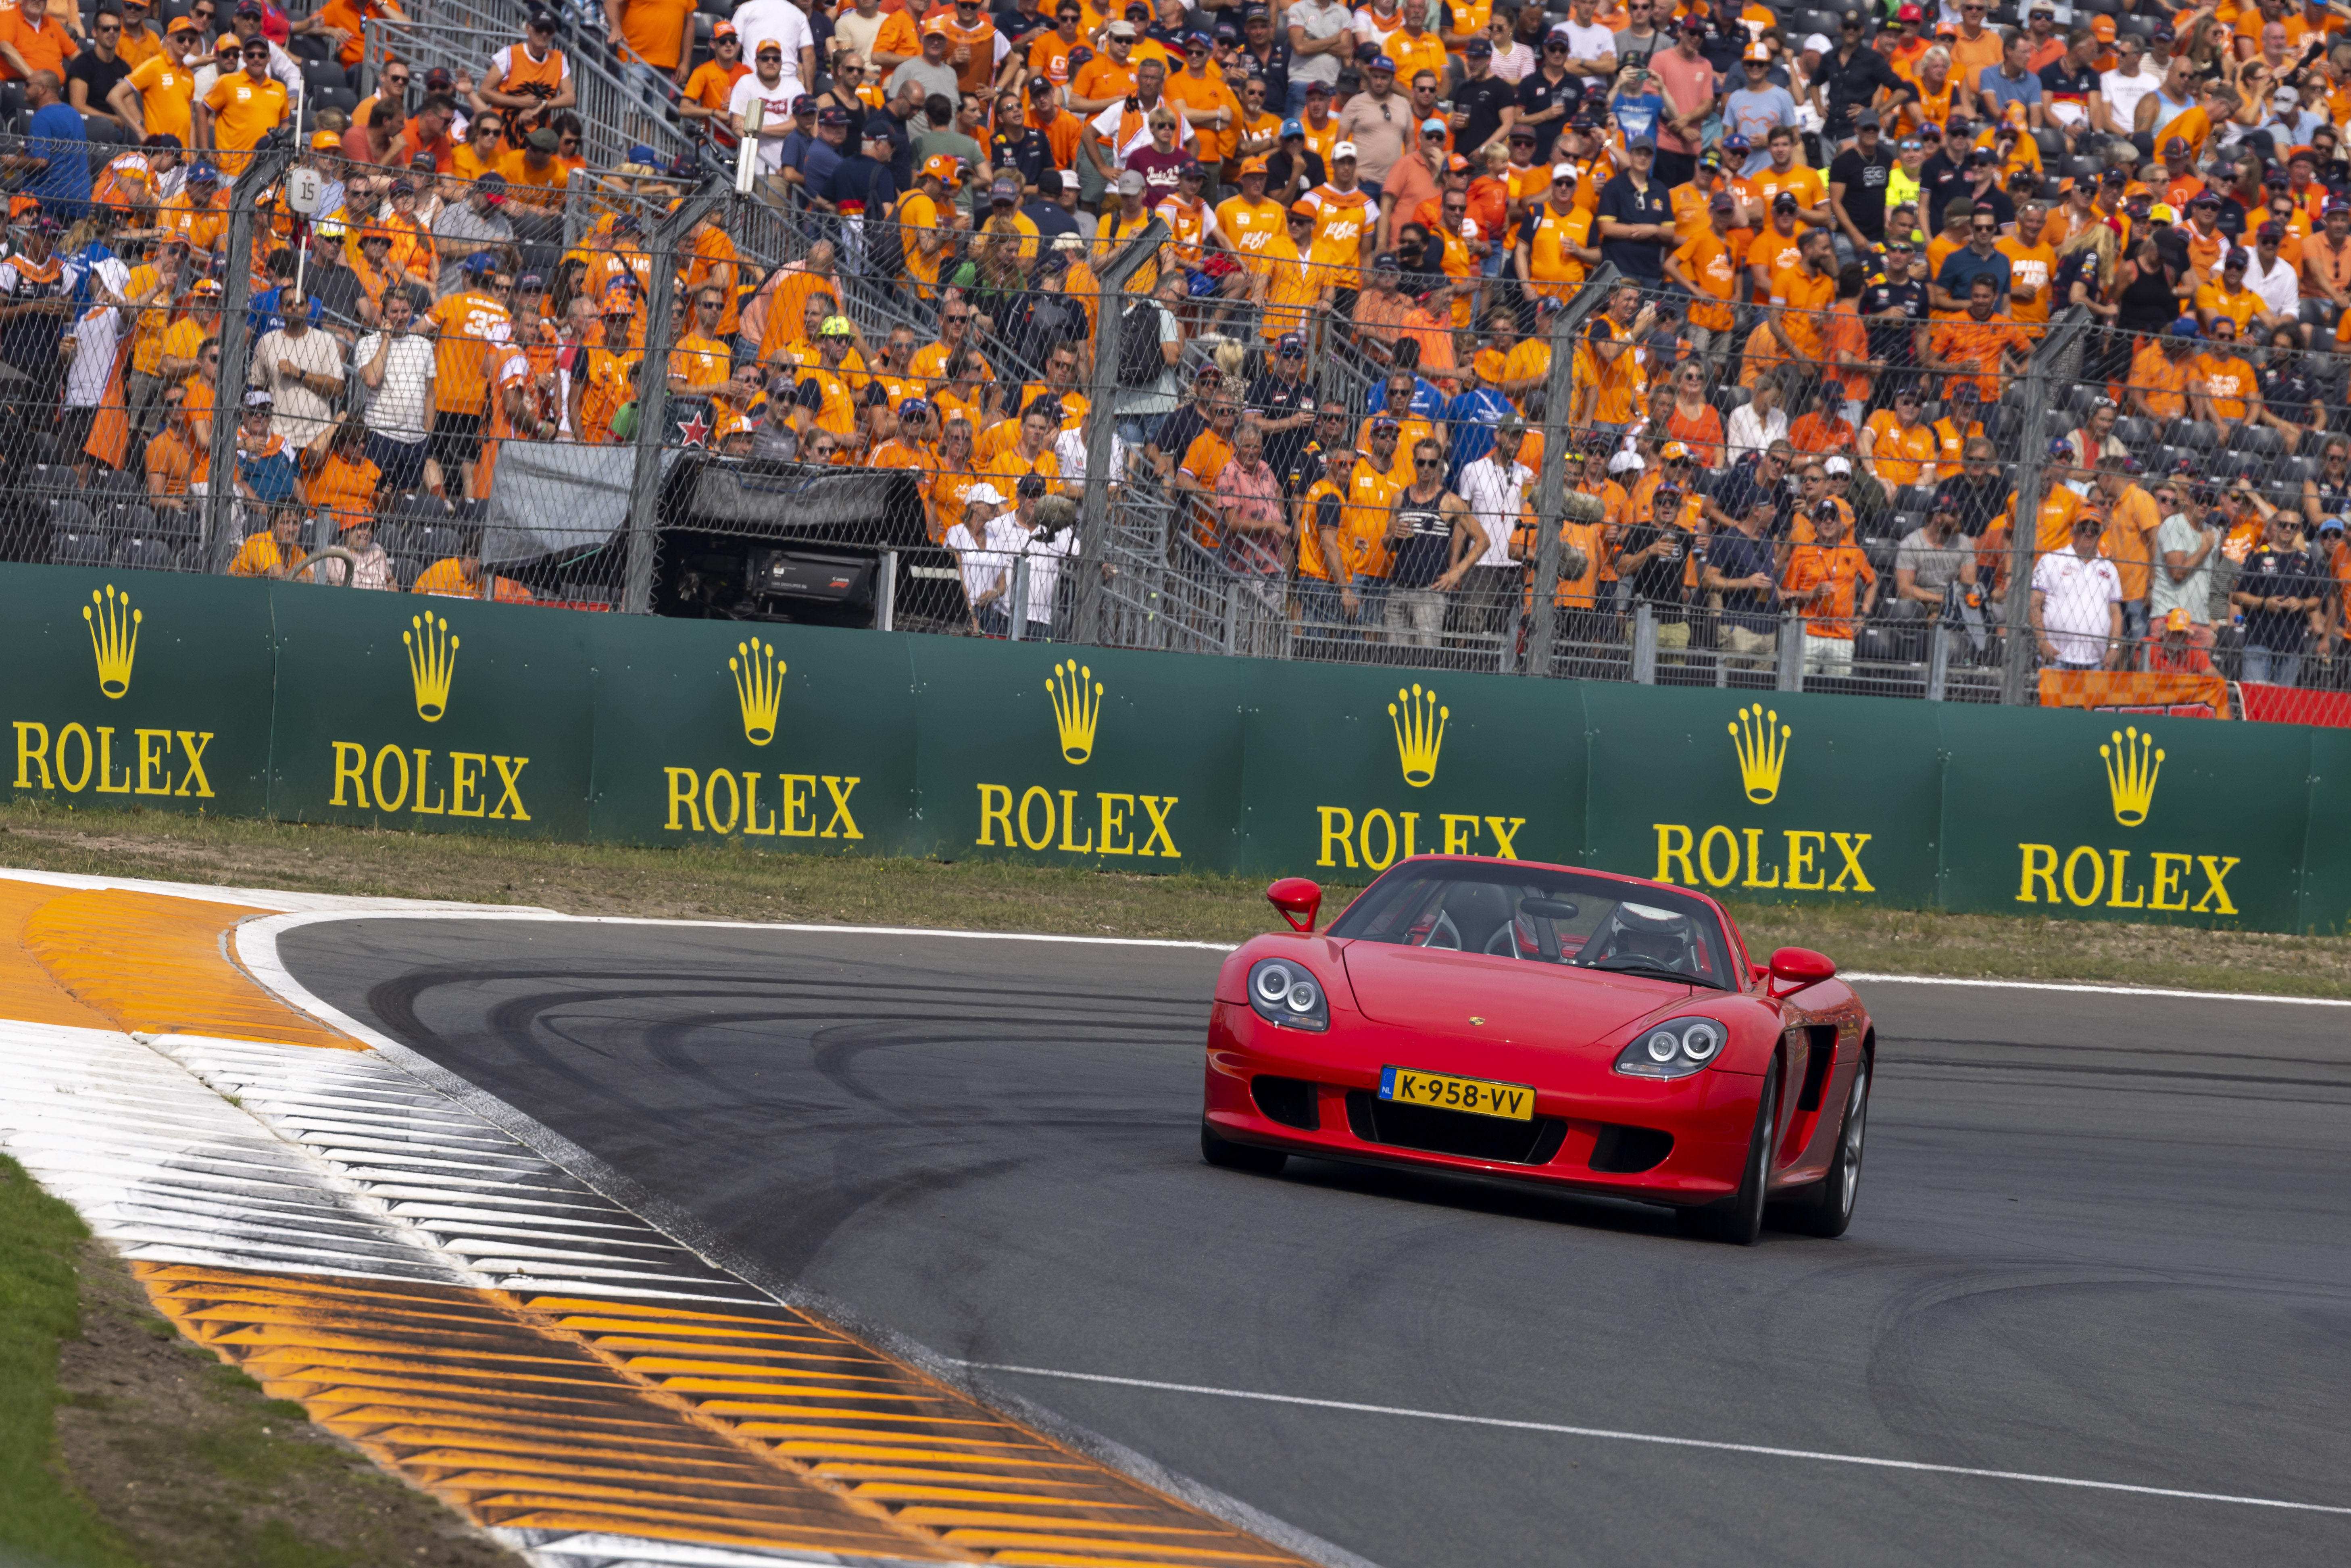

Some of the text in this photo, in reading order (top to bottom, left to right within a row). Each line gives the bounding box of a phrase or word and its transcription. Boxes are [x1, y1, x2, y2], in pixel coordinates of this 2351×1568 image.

[300, 182, 315, 200] 15
[13, 721, 215, 797] ROLEX
[329, 741, 531, 821] ROLEX
[664, 767, 864, 839] ROLEX
[976, 783, 1182, 858] ROLEX
[1316, 806, 1526, 871] ROLEX
[1652, 824, 1876, 892] ROLEX
[2015, 843, 2241, 915] ROLEX
[1382, 1086, 1392, 1095] NL
[1401, 1075, 1524, 1114] K-958-VV
